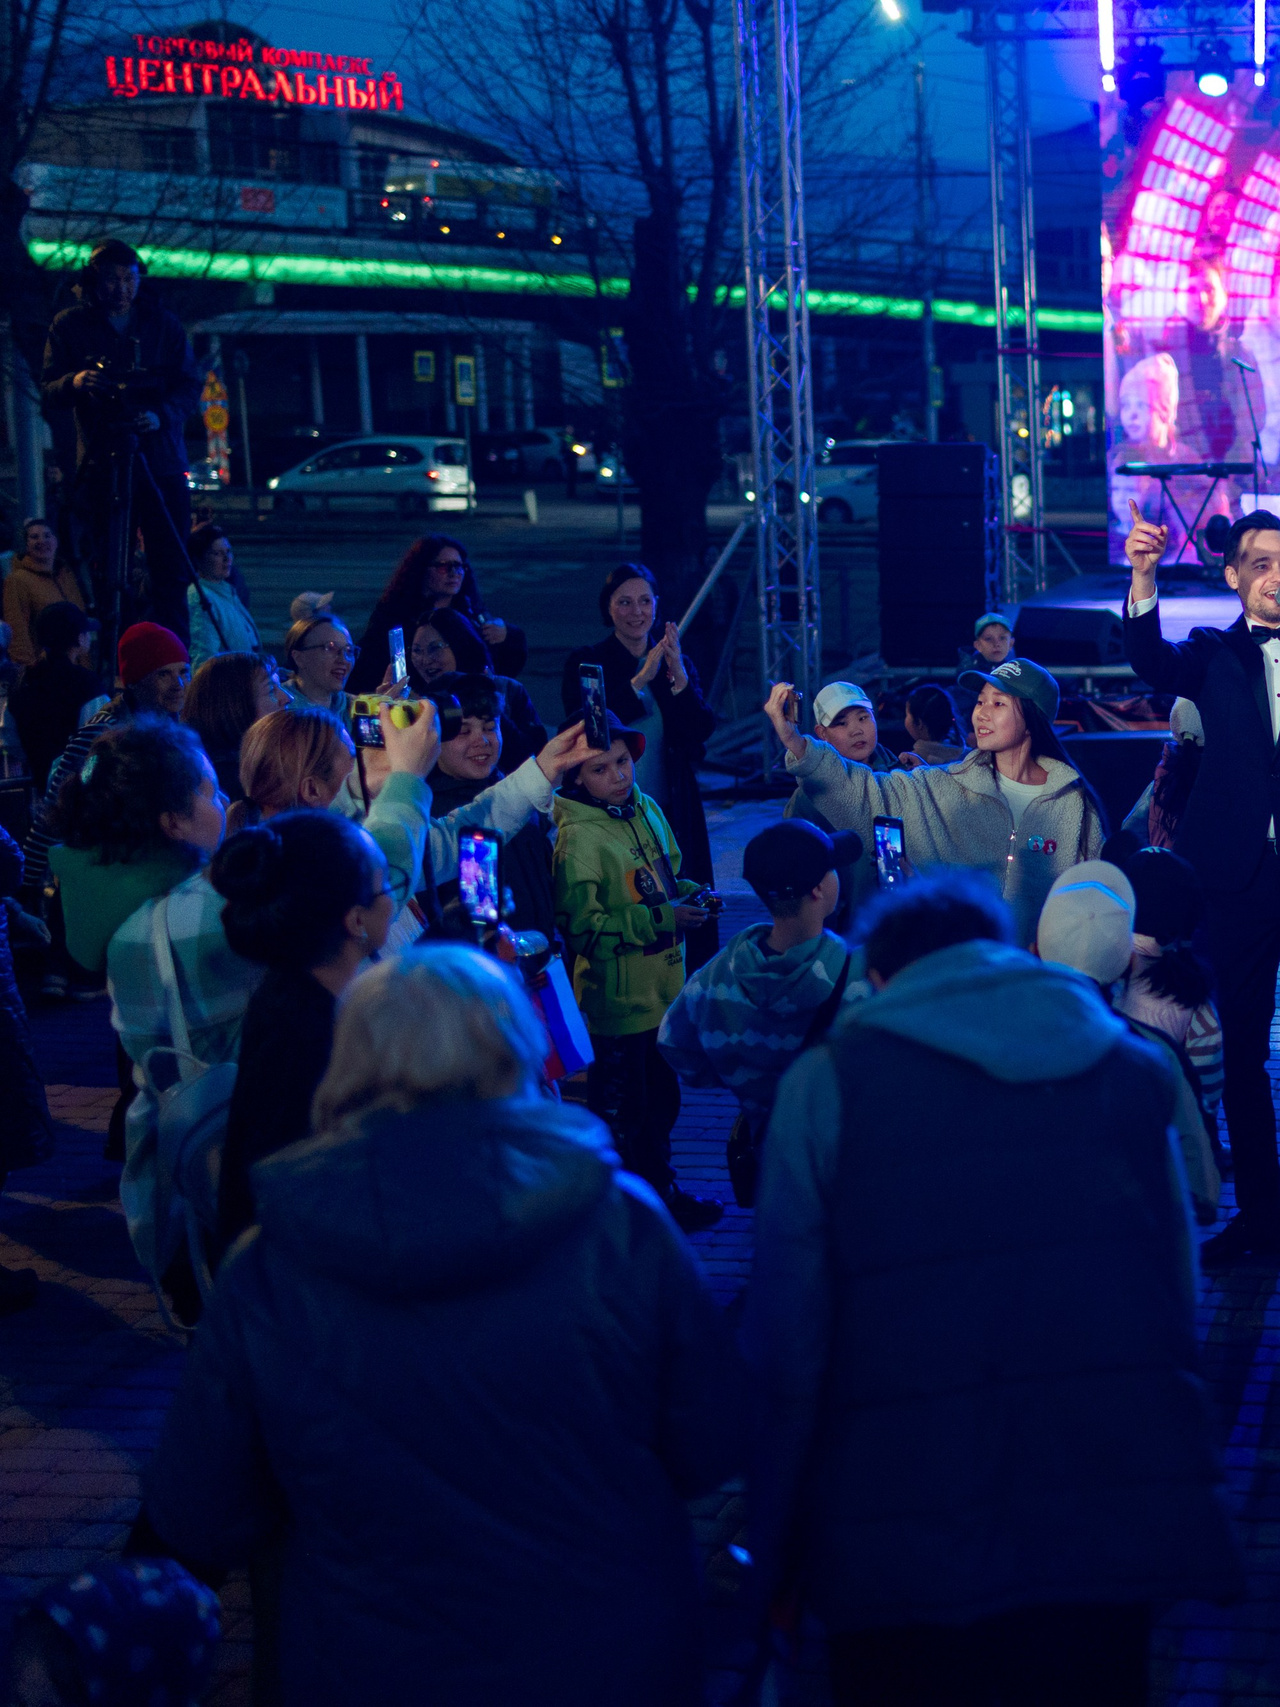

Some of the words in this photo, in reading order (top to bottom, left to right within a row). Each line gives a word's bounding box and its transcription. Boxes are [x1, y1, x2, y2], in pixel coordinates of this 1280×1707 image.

[132, 34, 253, 63] ТОРГОВЫЙ
[261, 46, 376, 77] КОМПЛЕКС
[104, 55, 405, 112] ЦЕНТРАЛЬНЫЙ
